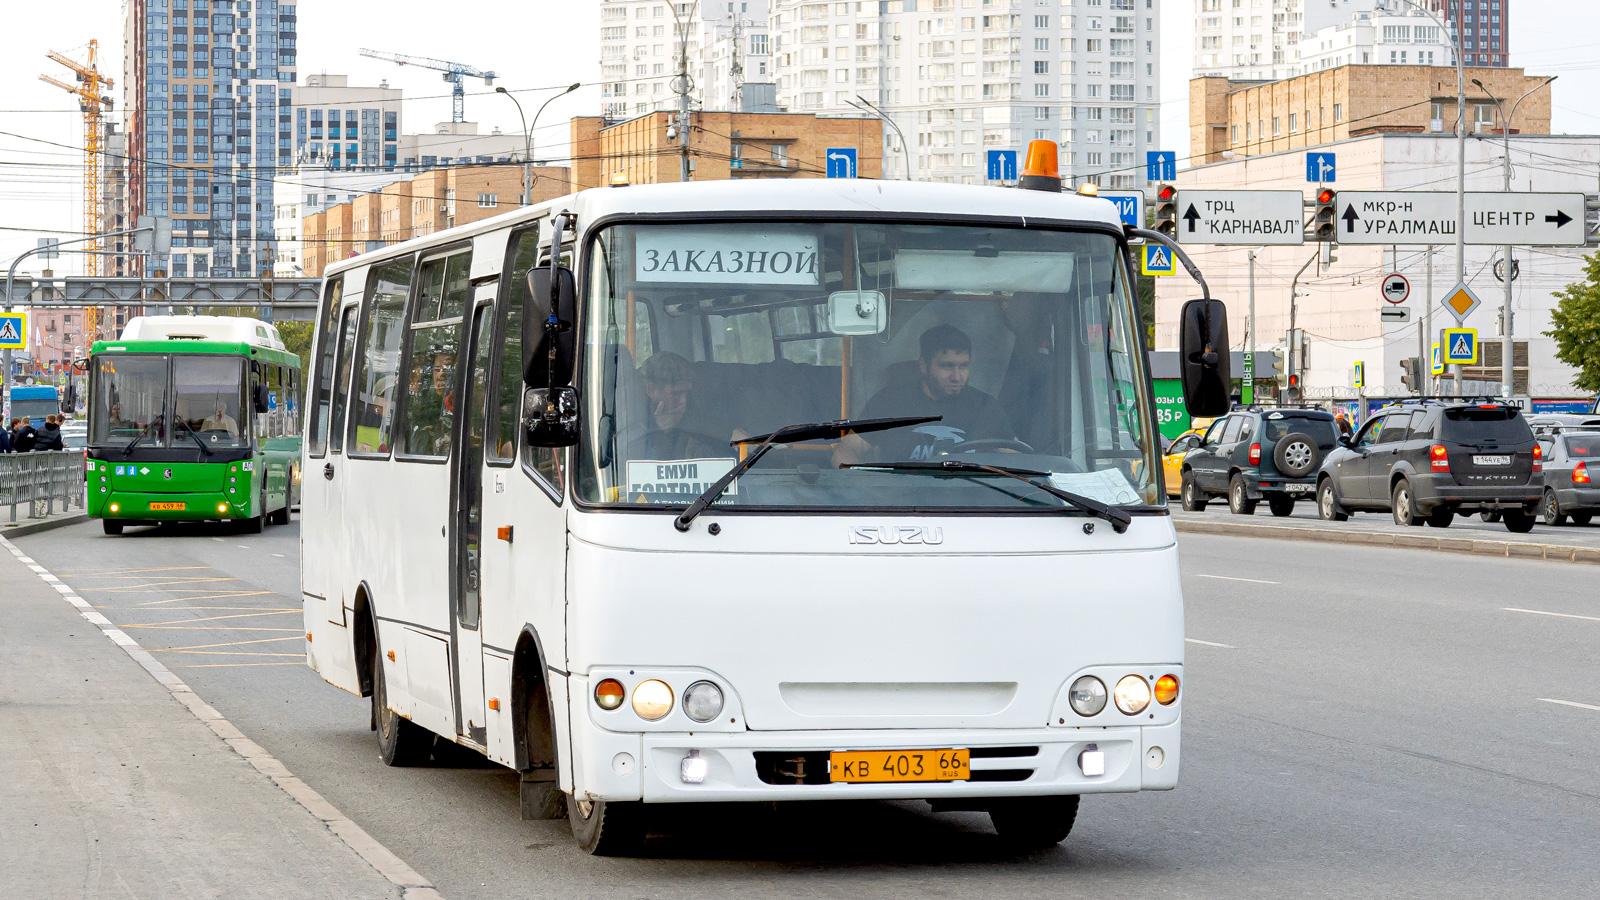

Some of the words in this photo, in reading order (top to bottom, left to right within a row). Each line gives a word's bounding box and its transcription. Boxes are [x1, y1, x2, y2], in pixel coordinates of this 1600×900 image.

[1205, 200, 1235, 213] трц
[1363, 201, 1413, 213] мкр-н
[1363, 219, 1456, 235] УРАЛМАШ
[1473, 211, 1535, 228] ЦЕНТР
[642, 245, 817, 274] ЗАКАЗНОЙ
[1242, 351, 1252, 387] ЦВЕТЫ
[656, 463, 698, 480] ЕМУП
[848, 525, 943, 545] ISUZU
[843, 760, 869, 778] КВ
[882, 754, 924, 777] 403
[939, 752, 961, 769] 66
